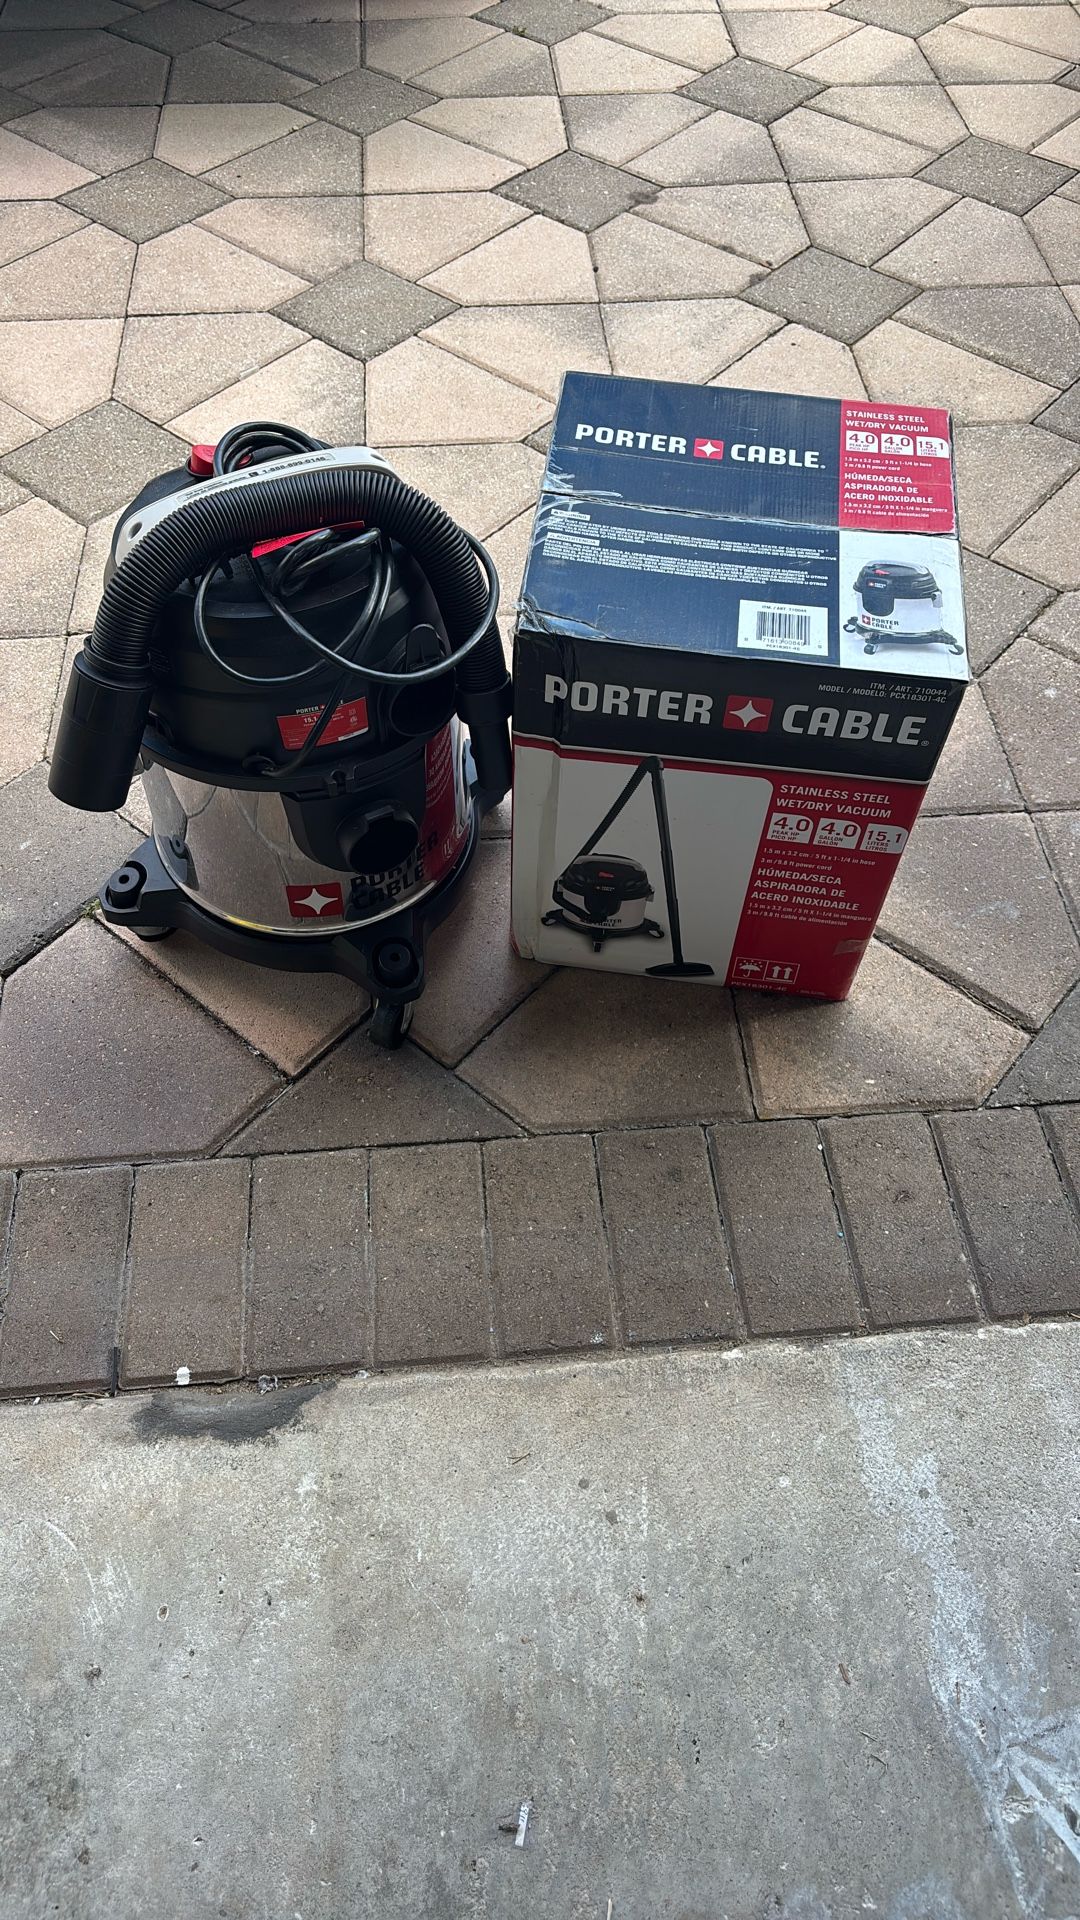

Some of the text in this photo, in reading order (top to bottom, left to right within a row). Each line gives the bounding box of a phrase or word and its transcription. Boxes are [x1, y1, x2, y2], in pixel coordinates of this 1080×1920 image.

[846, 411, 925, 423] STAINLESS STEEL
[846, 420, 928, 433] WET/DRY VACUUM
[575, 423, 687, 455] PORTER
[849, 433, 875, 444] 4.0
[884, 436, 910, 447] 4.0
[919, 441, 944, 450] 15.1
[845, 472, 912, 484] HÚMEDA/SECA
[844, 483, 903, 493] ASPIRADORA
[844, 492, 933, 505] ACERO INOXIDABLE
[872, 617, 899, 626] PORTER
[818, 685, 846, 693] MODEL
[852, 688, 888, 697] MODELO:
[890, 692, 947, 703] PCX18301-4C
[915, 687, 947, 696] 710044
[544, 674, 714, 725] PORTER
[780, 785, 892, 804] STAINLESS STEEL
[776, 798, 892, 818] WET/DRY VACUUM
[773, 817, 811, 832] 4.0
[821, 822, 858, 838] 4.0
[867, 830, 902, 844] 15.1
[757, 867, 843, 885] HÚMEDA/SECA
[754, 880, 846, 897] ASPIRADORA DE
[751, 891, 860, 911] ACERO INOXIDABLE
